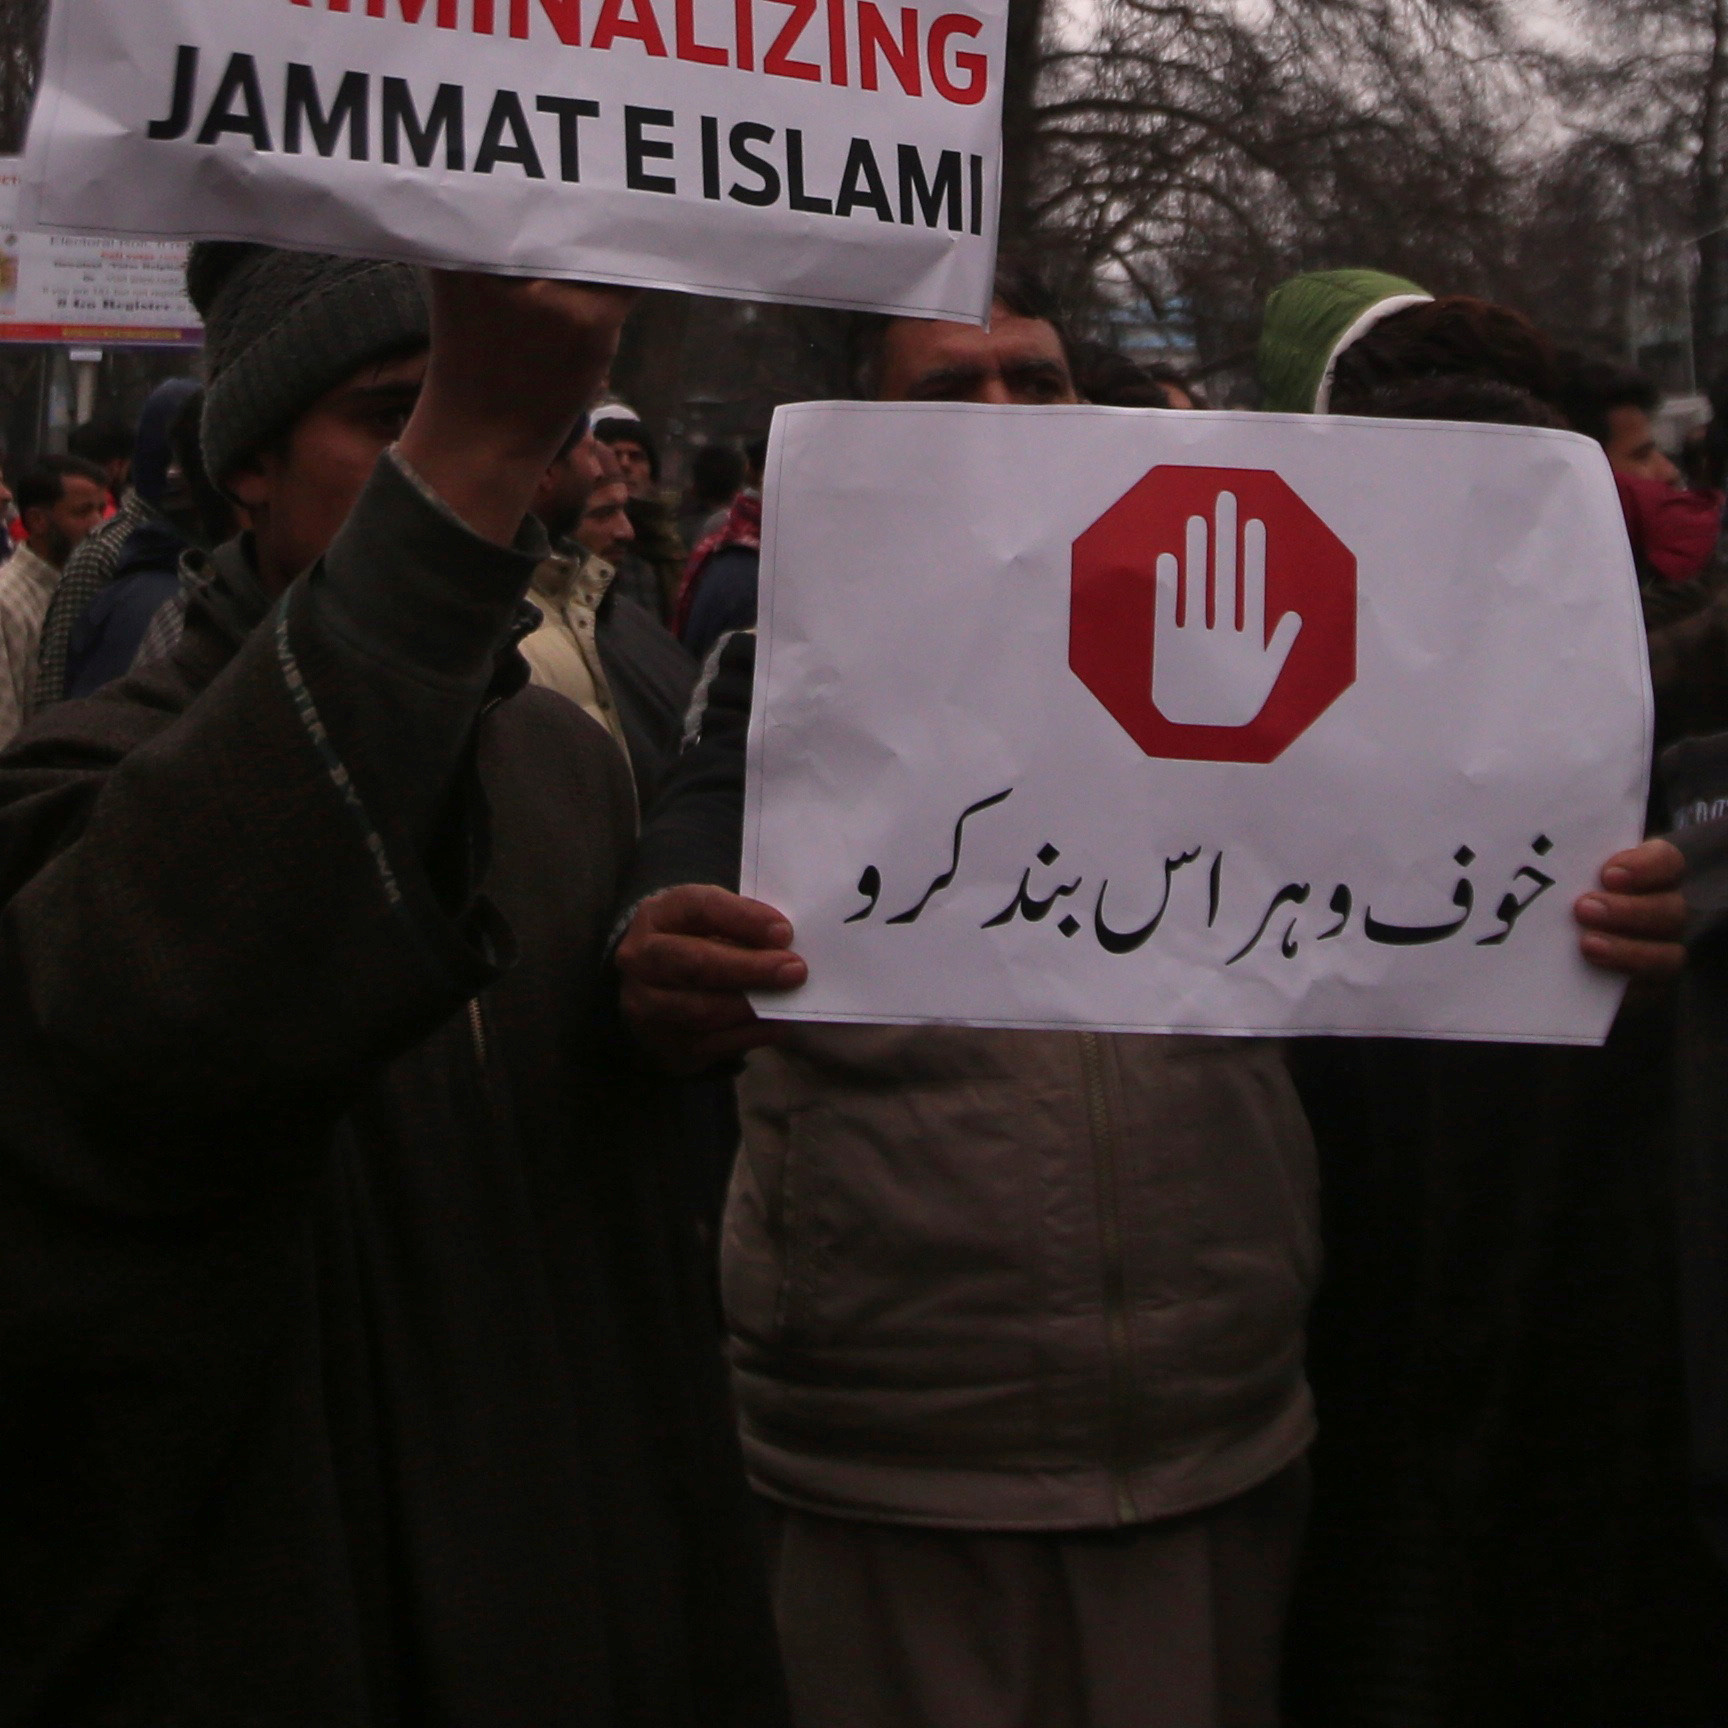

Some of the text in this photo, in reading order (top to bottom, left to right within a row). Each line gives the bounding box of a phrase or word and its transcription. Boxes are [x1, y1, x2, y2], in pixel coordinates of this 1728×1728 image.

[146, 45, 983, 236] JAMMAT E ISLAMI
[843, 787, 1014, 925] کرو
[980, 842, 1082, 938] بند
[1363, 834, 1556, 946] خوف
